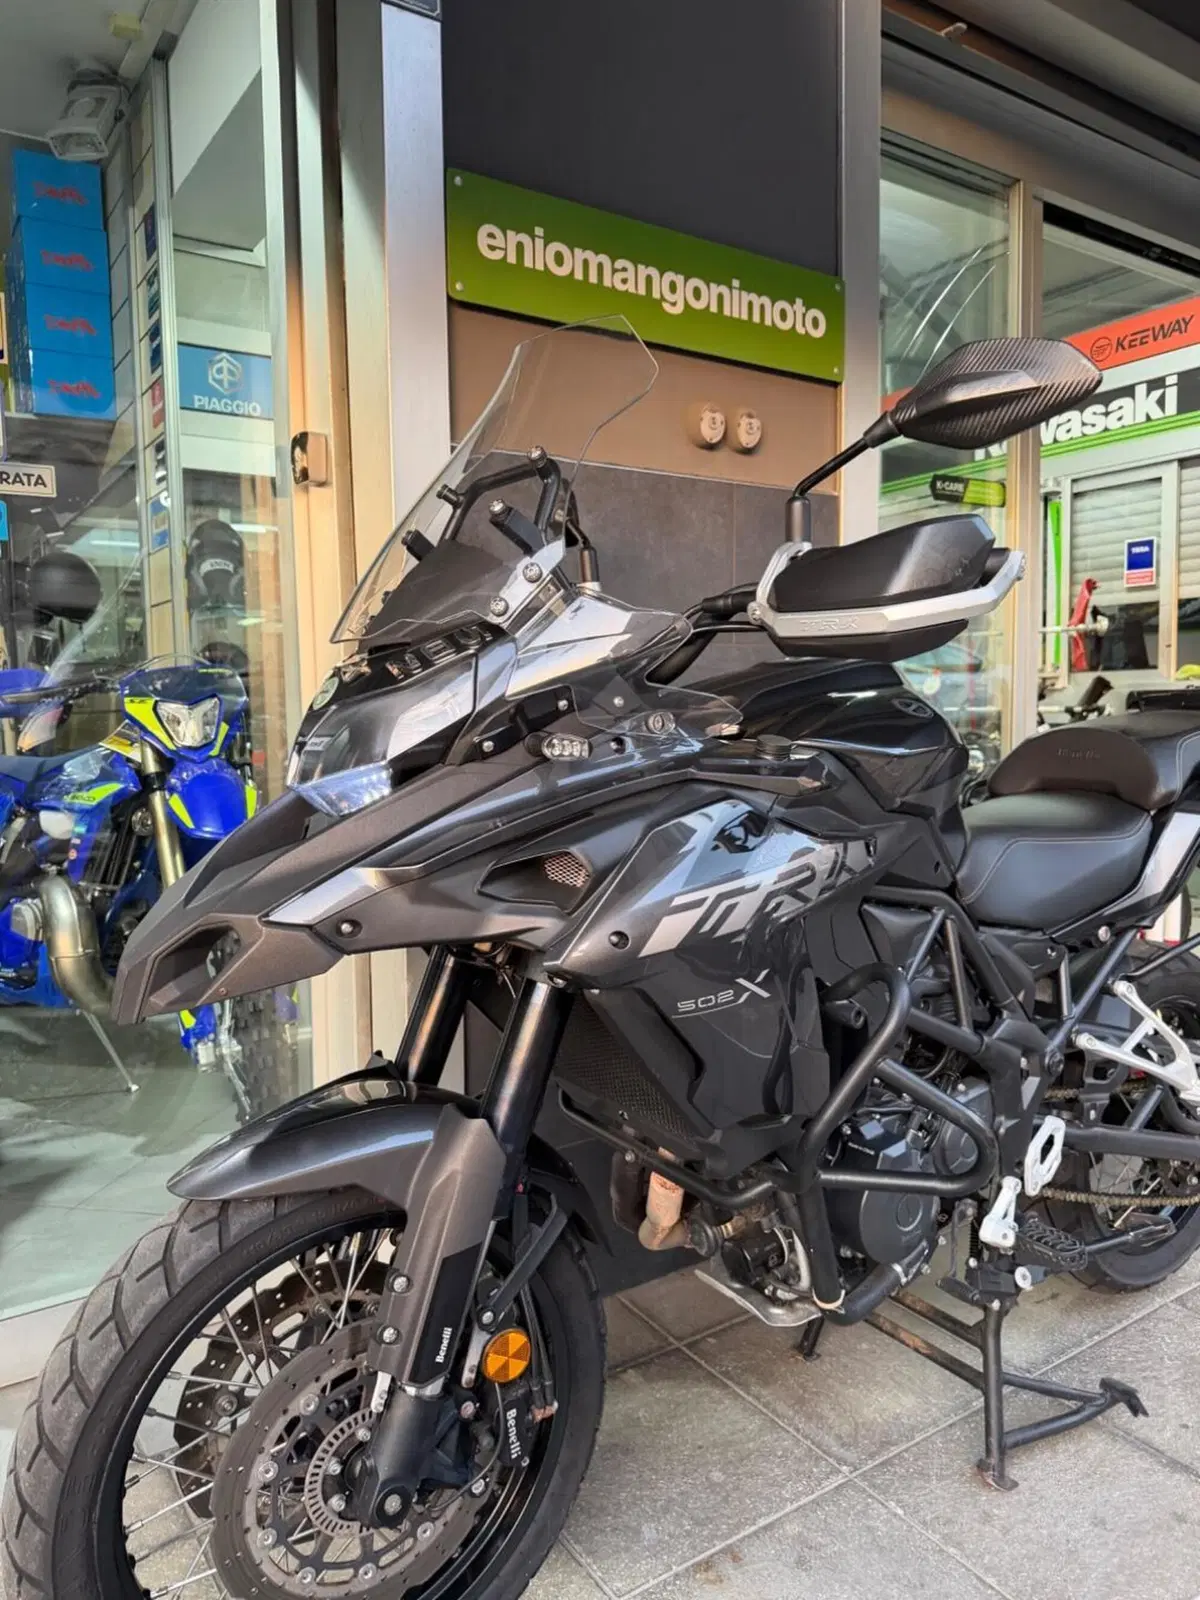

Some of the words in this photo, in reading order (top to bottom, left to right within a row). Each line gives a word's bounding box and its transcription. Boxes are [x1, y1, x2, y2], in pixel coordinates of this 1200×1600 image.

[477, 223, 827, 339] eniomangonimoto
[1115, 314, 1195, 353] KEEWAY
[193, 395, 261, 417] PIAGGIO
[677, 968, 771, 1013] 502X
[435, 1327, 453, 1363] Benelli
[506, 1408, 522, 1460] Benelli
